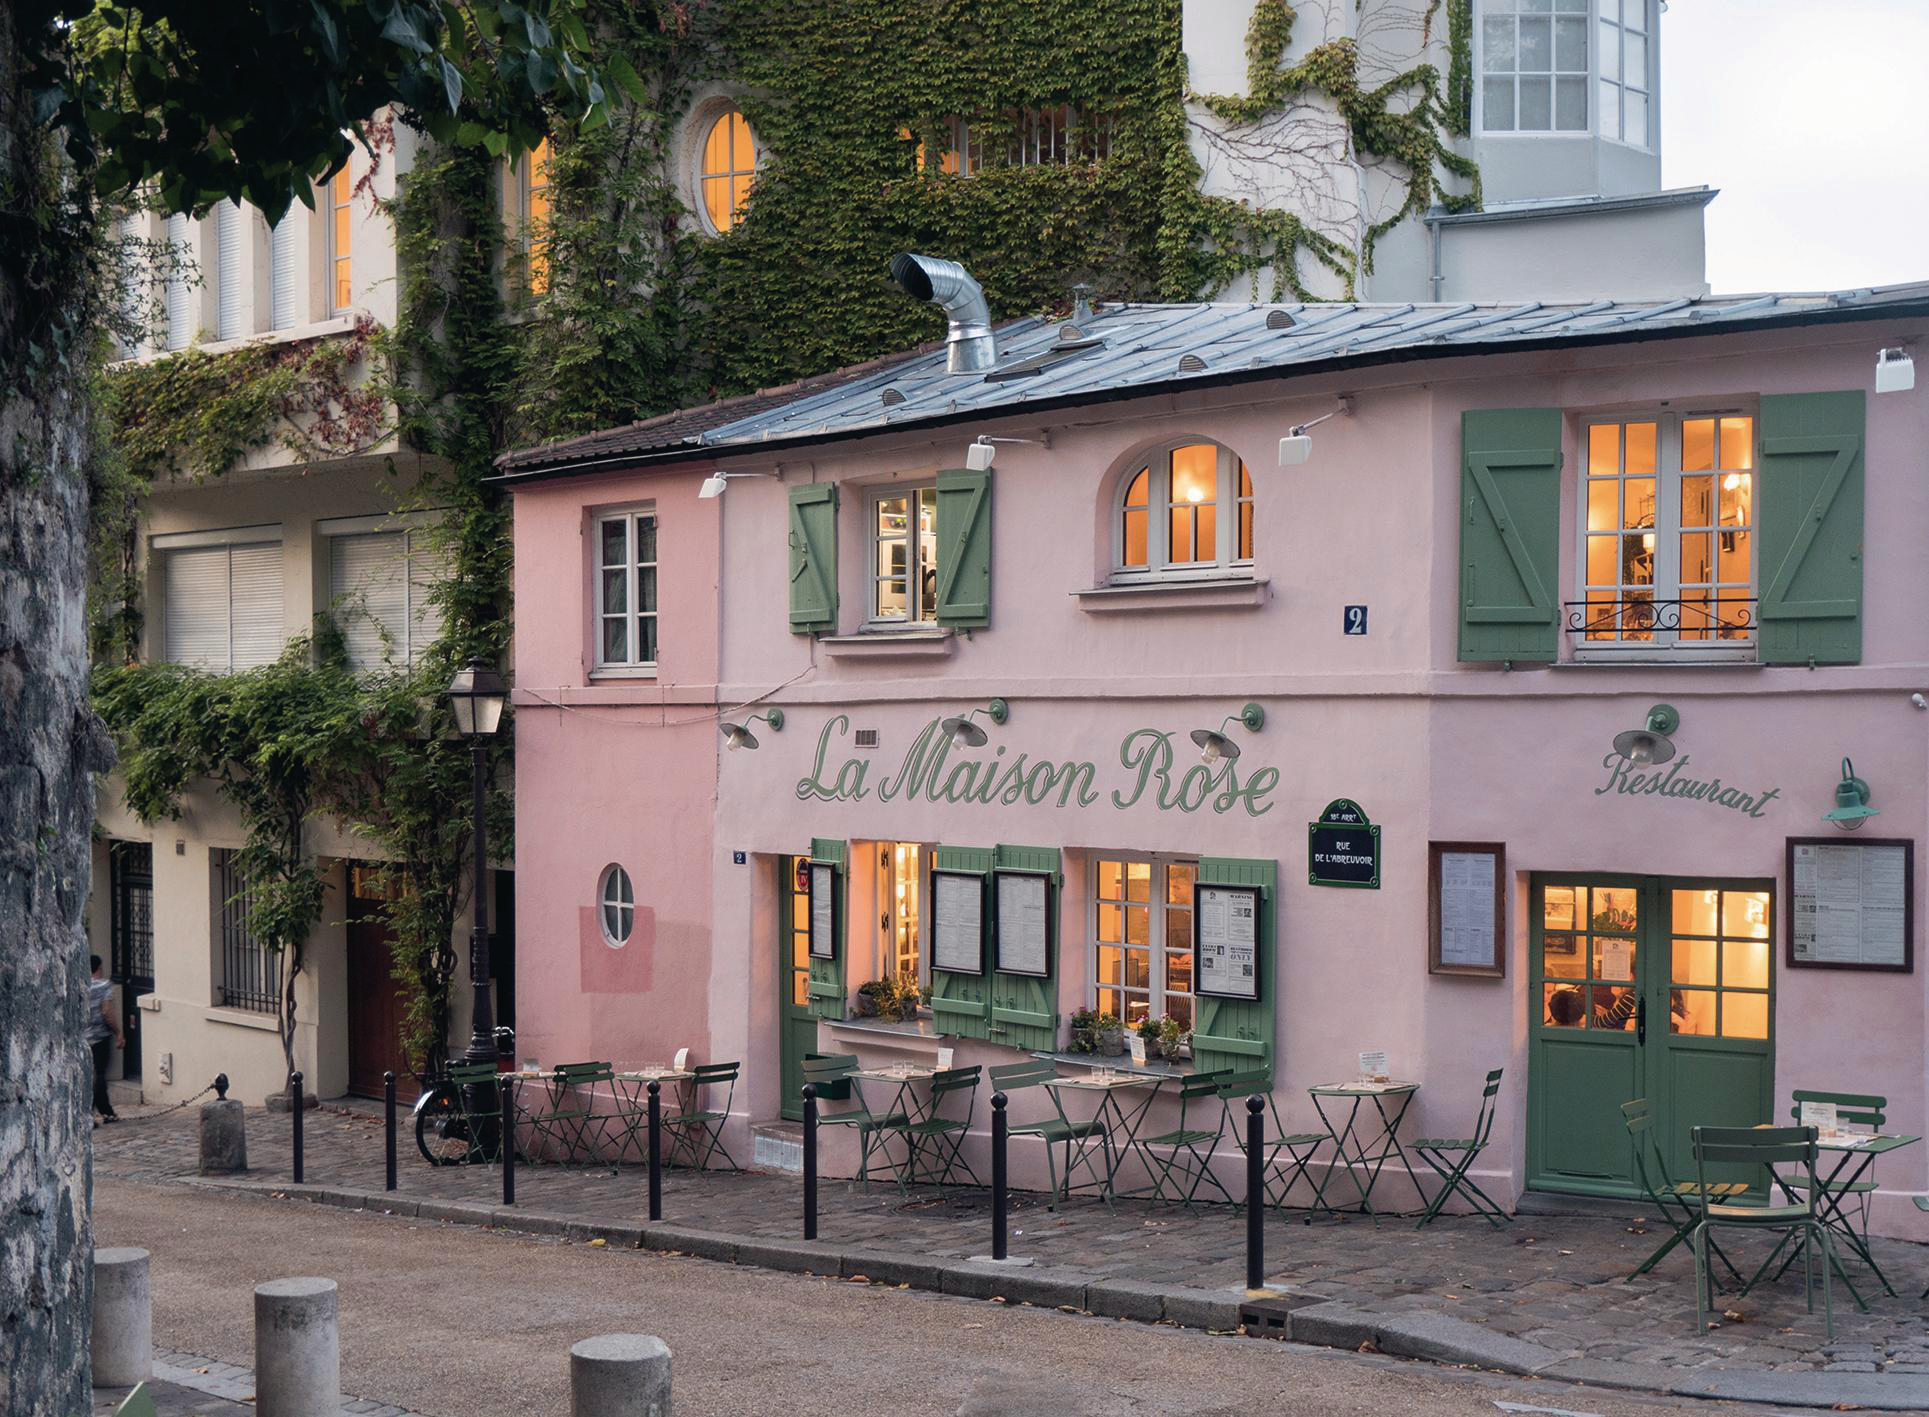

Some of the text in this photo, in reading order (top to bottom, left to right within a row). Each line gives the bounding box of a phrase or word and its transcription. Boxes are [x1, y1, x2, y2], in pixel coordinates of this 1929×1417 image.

[1349, 608, 1362, 634] 2
[795, 713, 1281, 818] La Maison Rose
[1594, 753, 1781, 819] Restaurant
[1336, 841, 1351, 851] RUE
[736, 853, 743, 863] 2
[1315, 854, 1373, 866] DE L'ABREUVOIR
